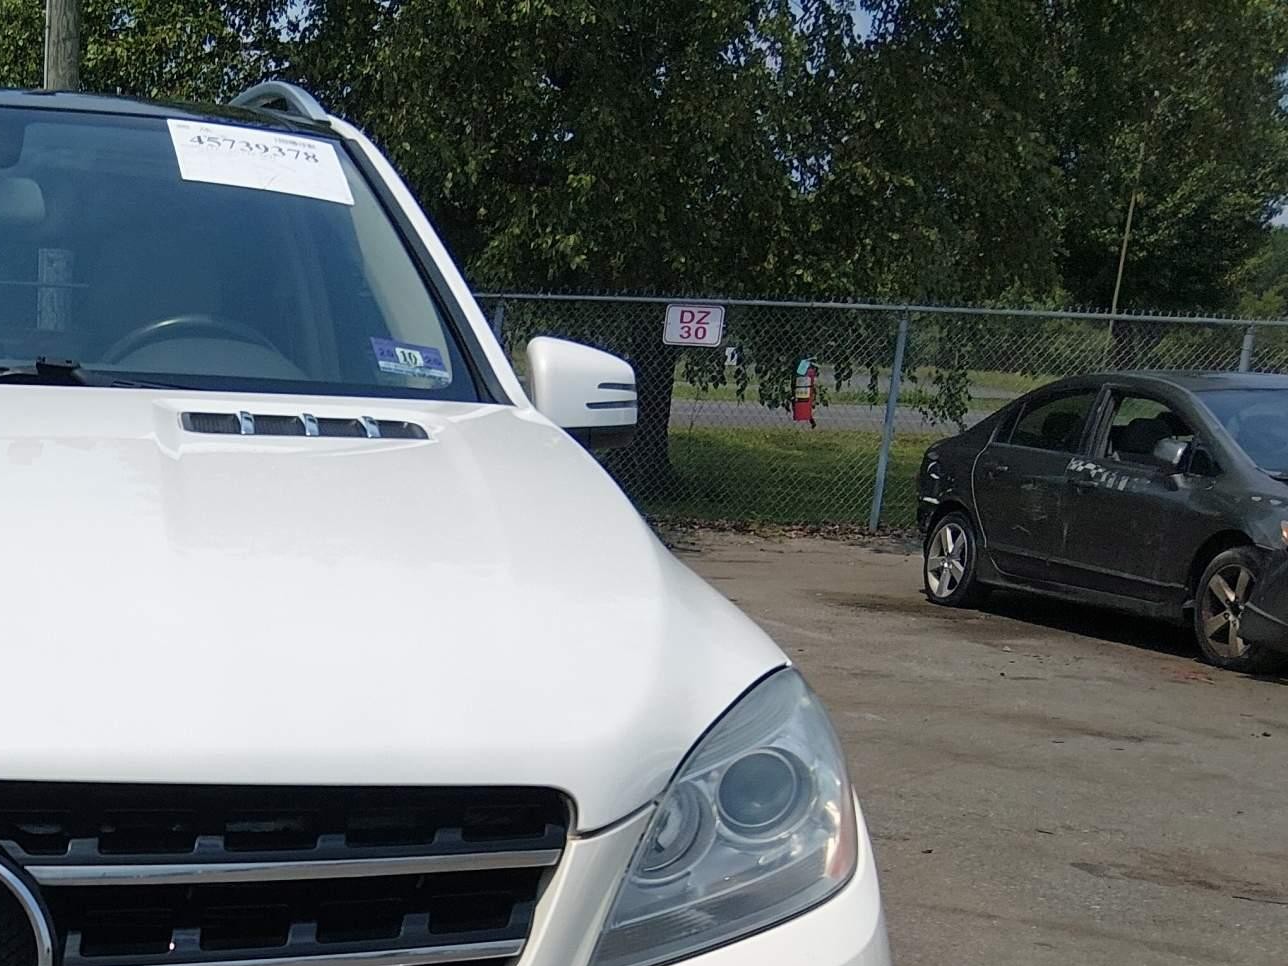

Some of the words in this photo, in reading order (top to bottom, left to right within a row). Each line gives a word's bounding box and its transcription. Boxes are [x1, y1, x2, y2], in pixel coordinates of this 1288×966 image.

[190, 134, 319, 164] 45739378
[679, 309, 711, 325] DZ
[679, 325, 707, 340] 30
